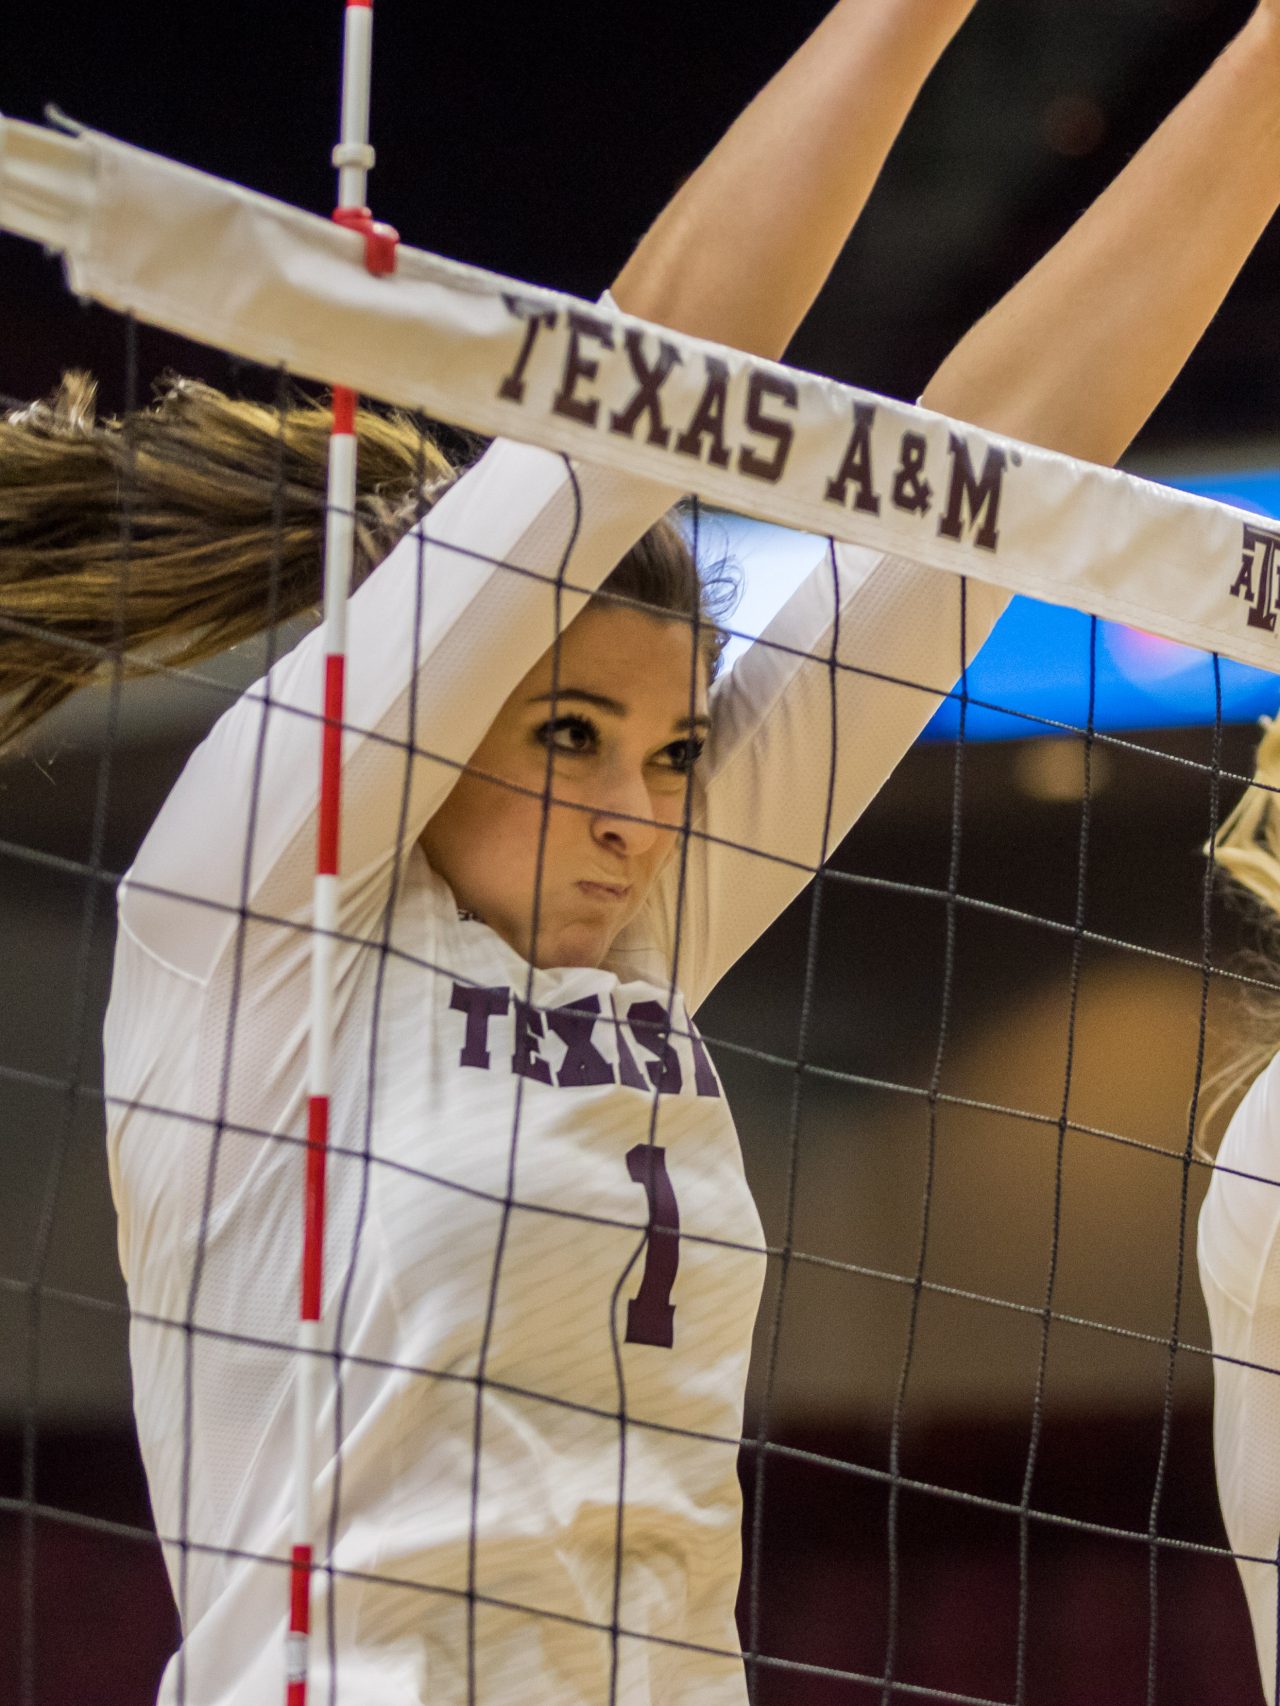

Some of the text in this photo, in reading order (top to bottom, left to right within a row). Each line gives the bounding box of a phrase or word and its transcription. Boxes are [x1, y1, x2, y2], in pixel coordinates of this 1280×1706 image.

[498, 292, 1009, 554] TEXAS A&M
[624, 1143, 680, 1350] 1
